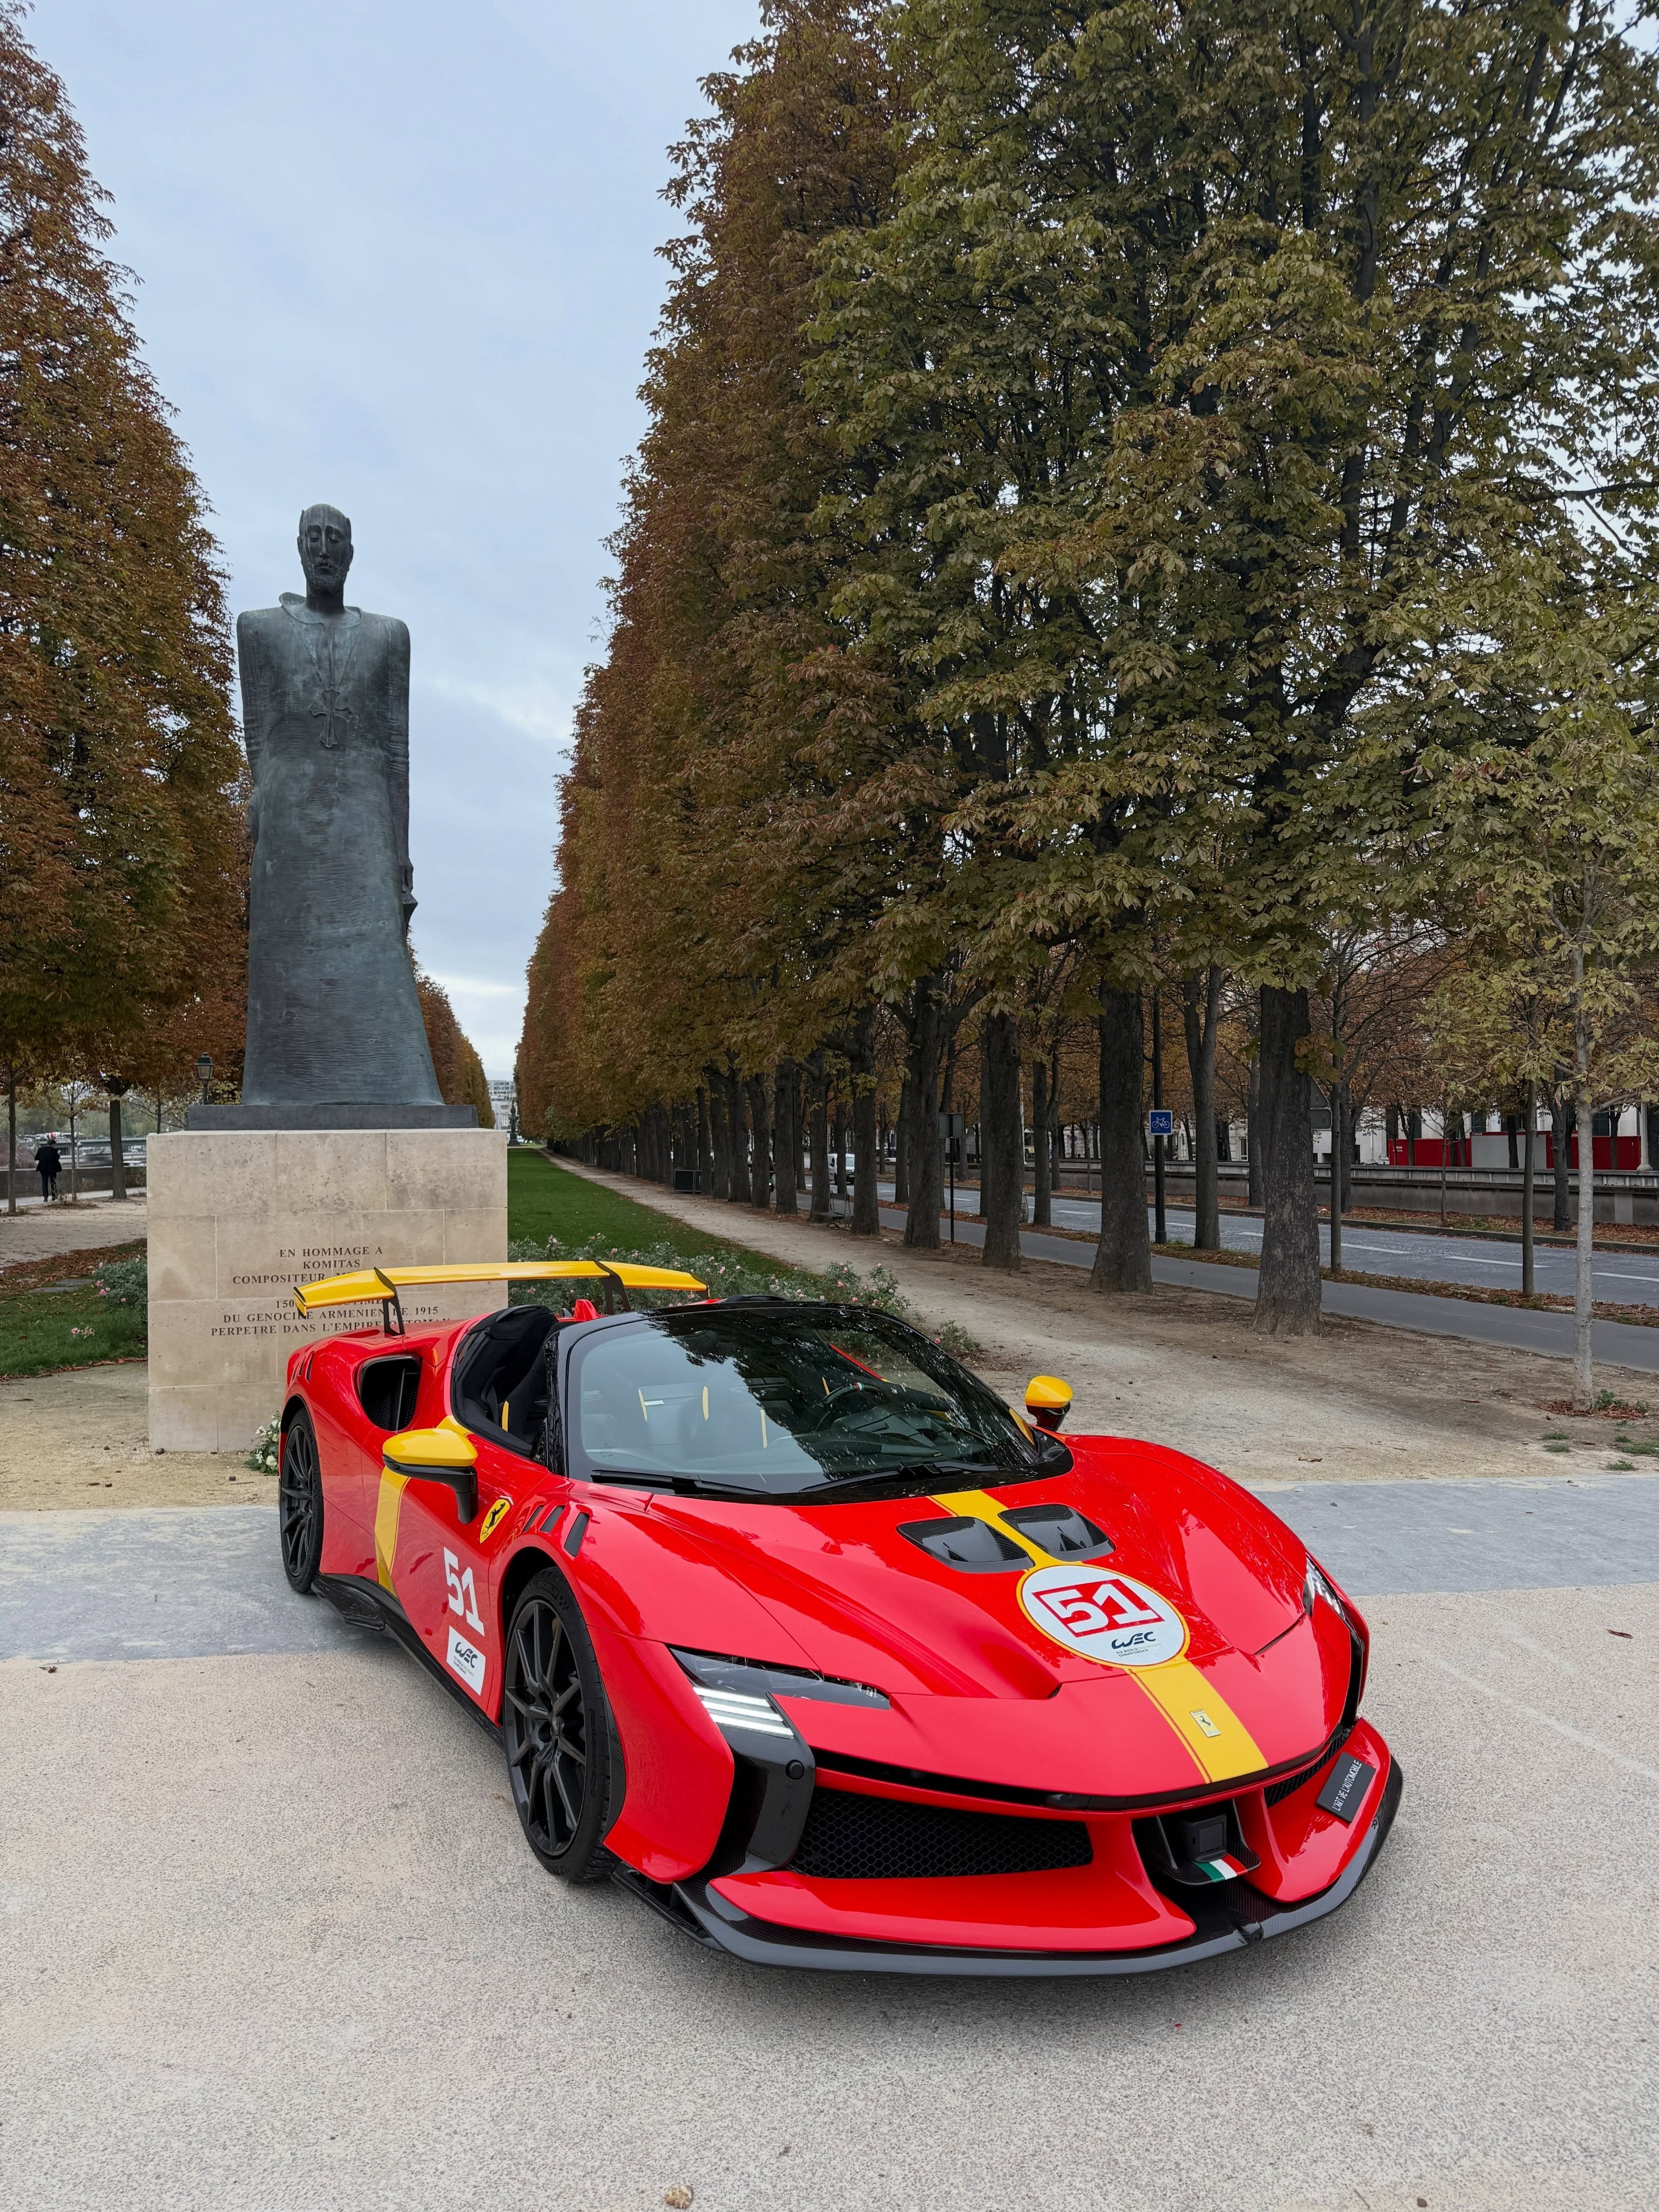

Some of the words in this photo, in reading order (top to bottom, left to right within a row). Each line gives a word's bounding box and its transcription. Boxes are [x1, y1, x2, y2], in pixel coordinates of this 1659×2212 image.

[280, 1249, 295, 1257] EN
[302, 1246, 369, 1257] HOMMAGE
[375, 1246, 383, 1254] A
[303, 1259, 360, 1269] KOMITAS
[233, 1273, 325, 1284] COMPOSITEUR
[224, 1314, 240, 1323] DU
[320, 1309, 385, 1319] ARMENIEN
[415, 1306, 439, 1315] 1915
[211, 1325, 277, 1336] PERPETRE
[284, 1324, 316, 1333] DANS
[444, 1547, 484, 1637] 51
[1039, 1583, 1159, 1634] 51
[1111, 1631, 1156, 1649] WEC
[455, 1642, 478, 1669] WEC
[1332, 1796, 1344, 1811] L'ART
[1338, 1790, 1348, 1799] DE
